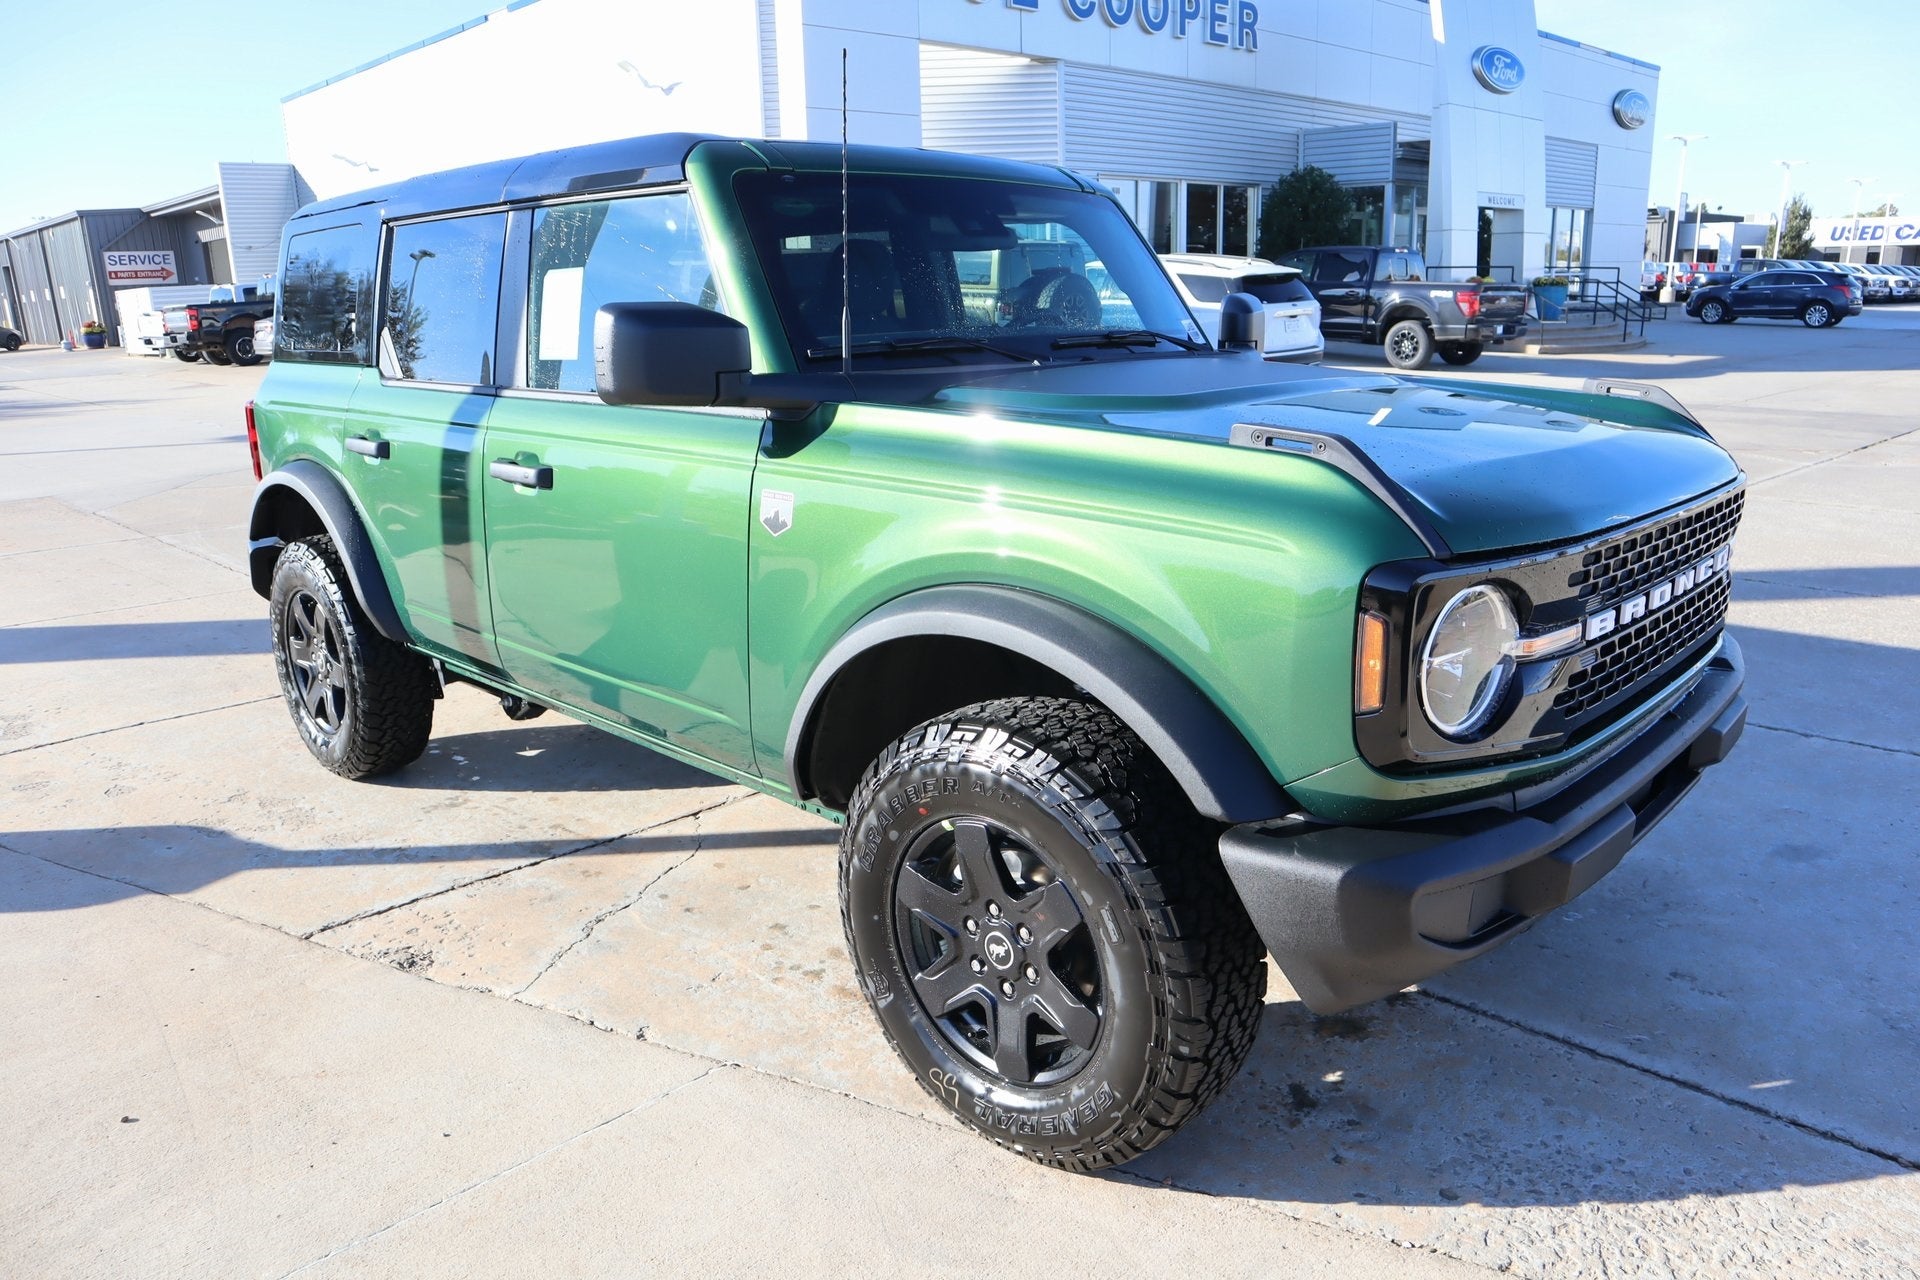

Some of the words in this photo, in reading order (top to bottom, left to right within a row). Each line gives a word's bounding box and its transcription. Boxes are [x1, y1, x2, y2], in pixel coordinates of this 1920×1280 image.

[1492, 54, 1518, 82] Ford
[1488, 196, 1516, 207] WELCOME
[107, 254, 171, 266] SERVICE
[137, 270, 167, 278] ENTRANCE
[1585, 544, 1729, 641] BRONCO
[859, 776, 960, 872] GRABBER
[973, 1080, 1116, 1136] GENERAL
